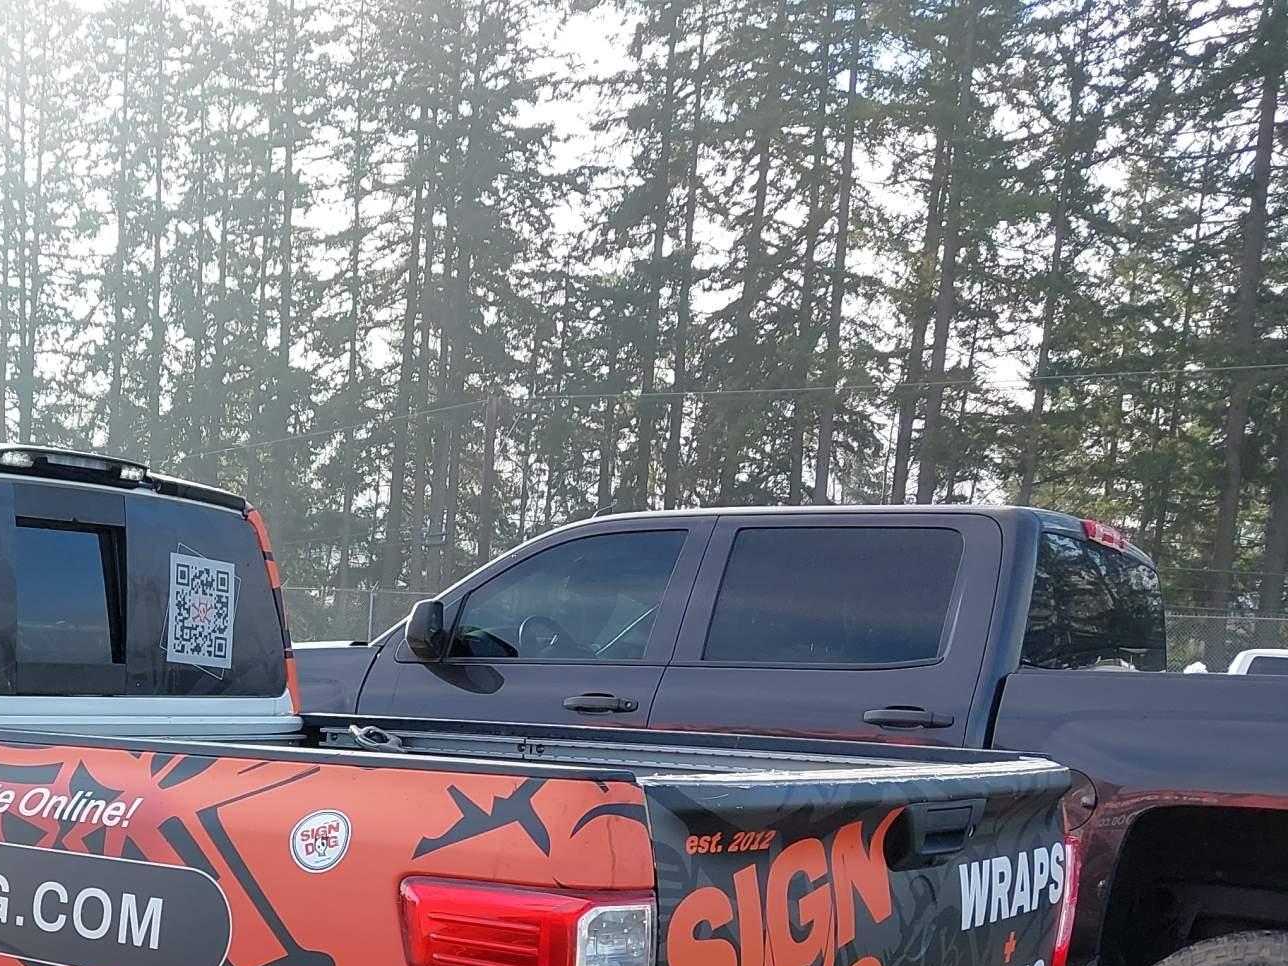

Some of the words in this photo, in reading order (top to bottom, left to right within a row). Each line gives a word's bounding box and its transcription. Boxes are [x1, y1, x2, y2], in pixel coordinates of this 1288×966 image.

[18, 785, 143, 828] Online!
[300, 822, 340, 842] SIGN
[686, 834, 722, 854] est.
[728, 831, 776, 852] 2012
[959, 841, 1065, 931] WRAPS
